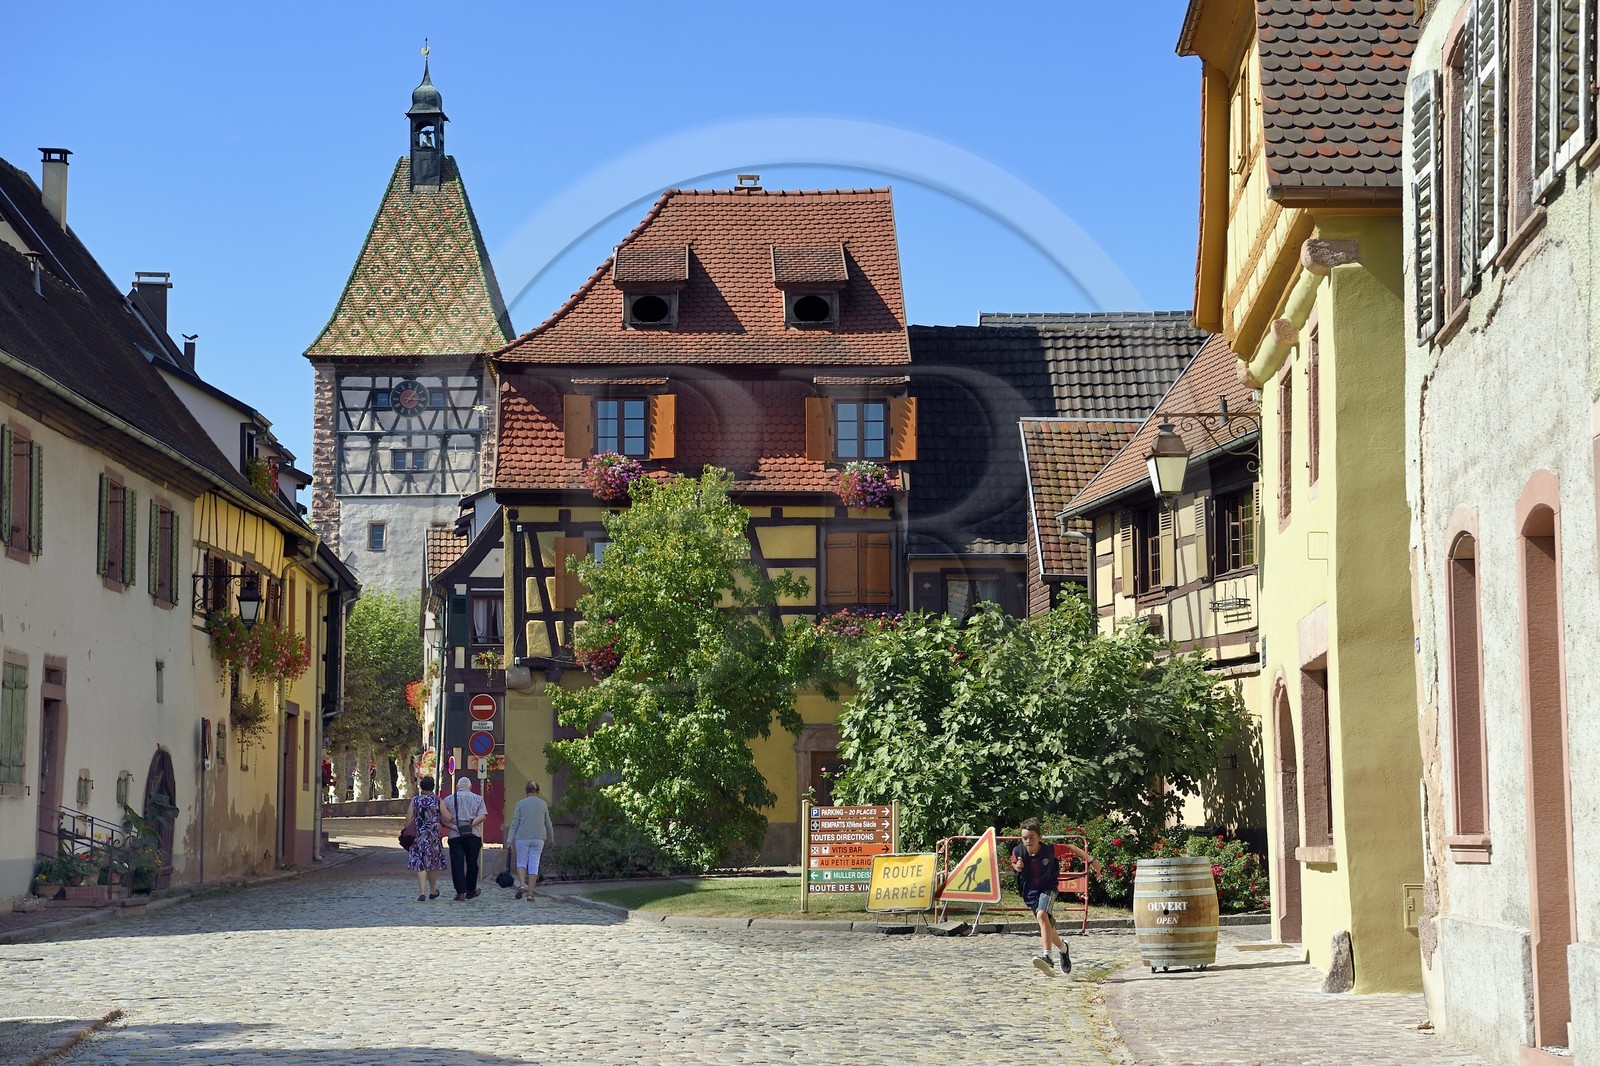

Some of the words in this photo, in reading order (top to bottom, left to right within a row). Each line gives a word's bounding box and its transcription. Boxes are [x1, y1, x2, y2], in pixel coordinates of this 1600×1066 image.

[882, 864, 924, 880] ROUTE
[875, 883, 926, 900] BARRÉE
[1147, 902, 1188, 912] OUVERT
[1156, 916, 1179, 925] OPEN
